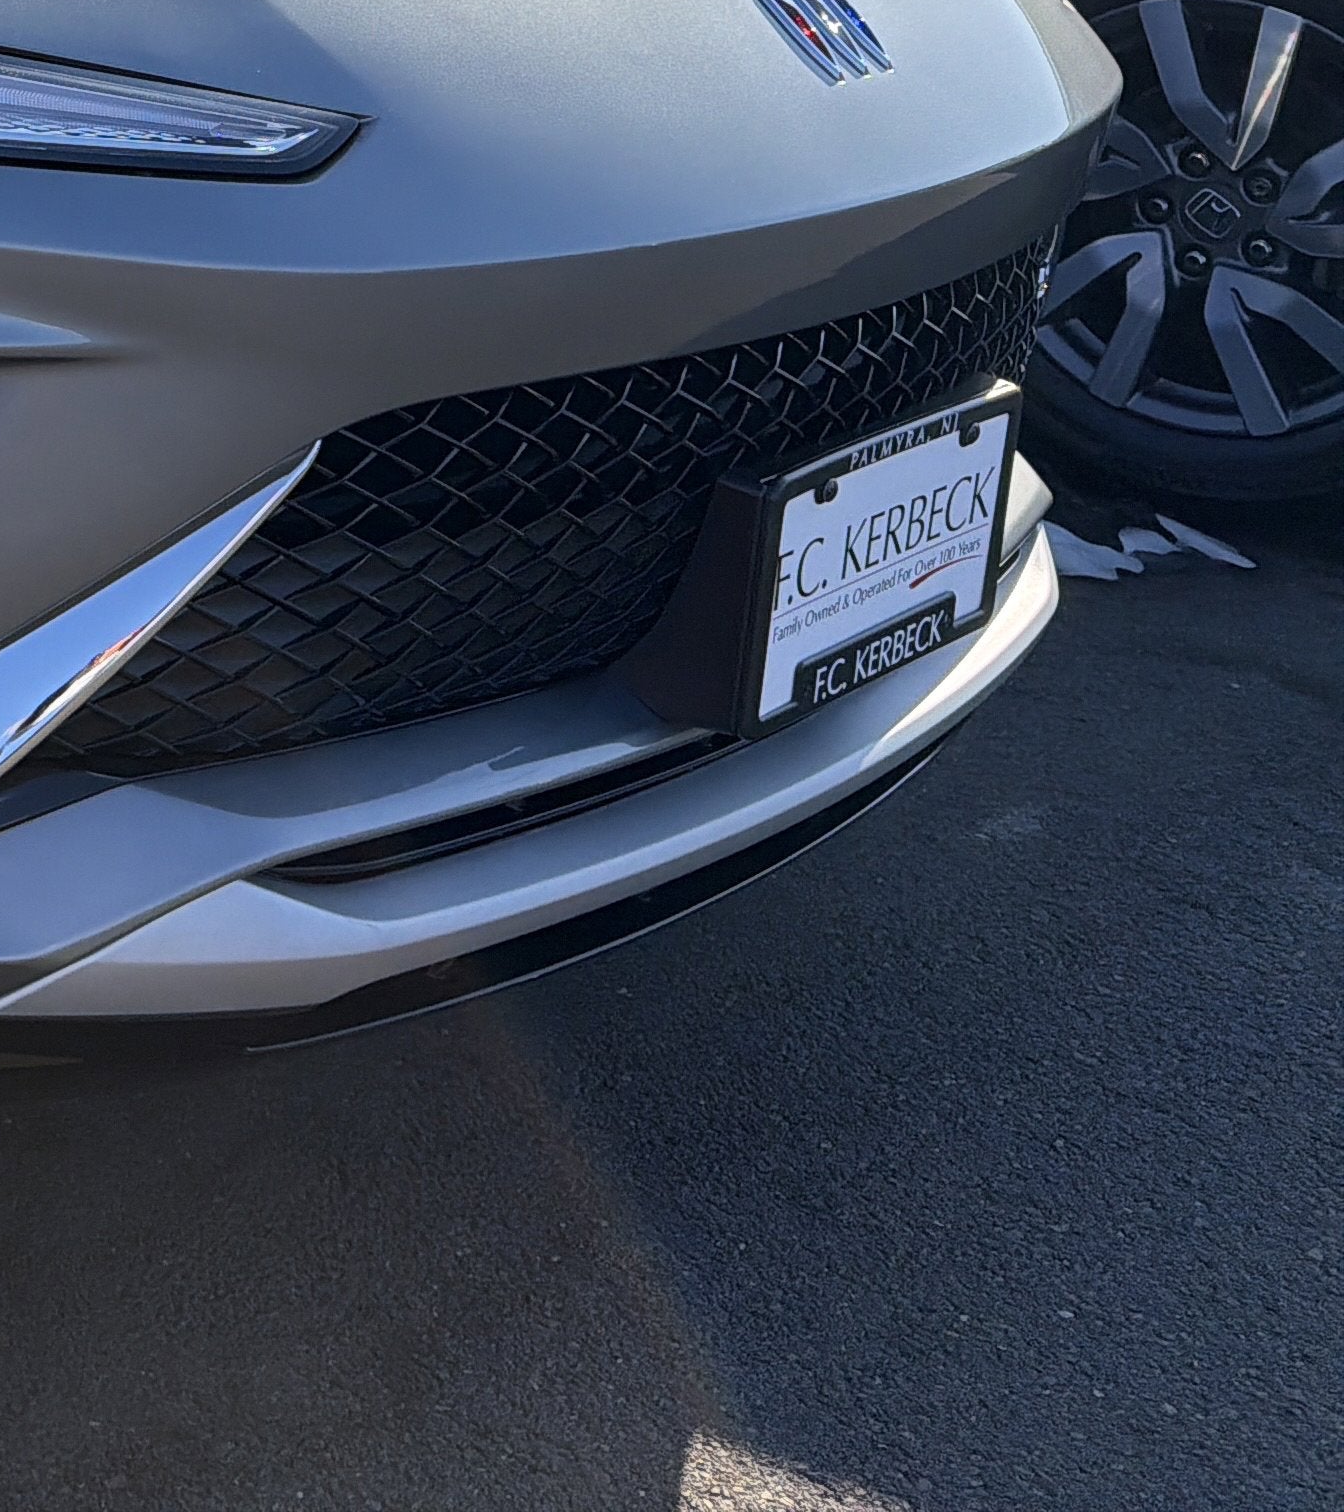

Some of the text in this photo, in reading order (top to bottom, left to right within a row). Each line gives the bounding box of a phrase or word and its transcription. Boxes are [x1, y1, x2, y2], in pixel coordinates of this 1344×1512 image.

[849, 412, 960, 470] PALMYRA, NJ
[773, 467, 996, 611] F.C. KERBECK
[772, 615, 804, 644] Family
[805, 596, 842, 628] Owned
[852, 573, 896, 606] Operated
[897, 566, 912, 585] For
[914, 557, 937, 576] Over
[938, 548, 956, 566] 100
[958, 539, 981, 556] Years
[813, 610, 945, 704] F.C. KERBECK
